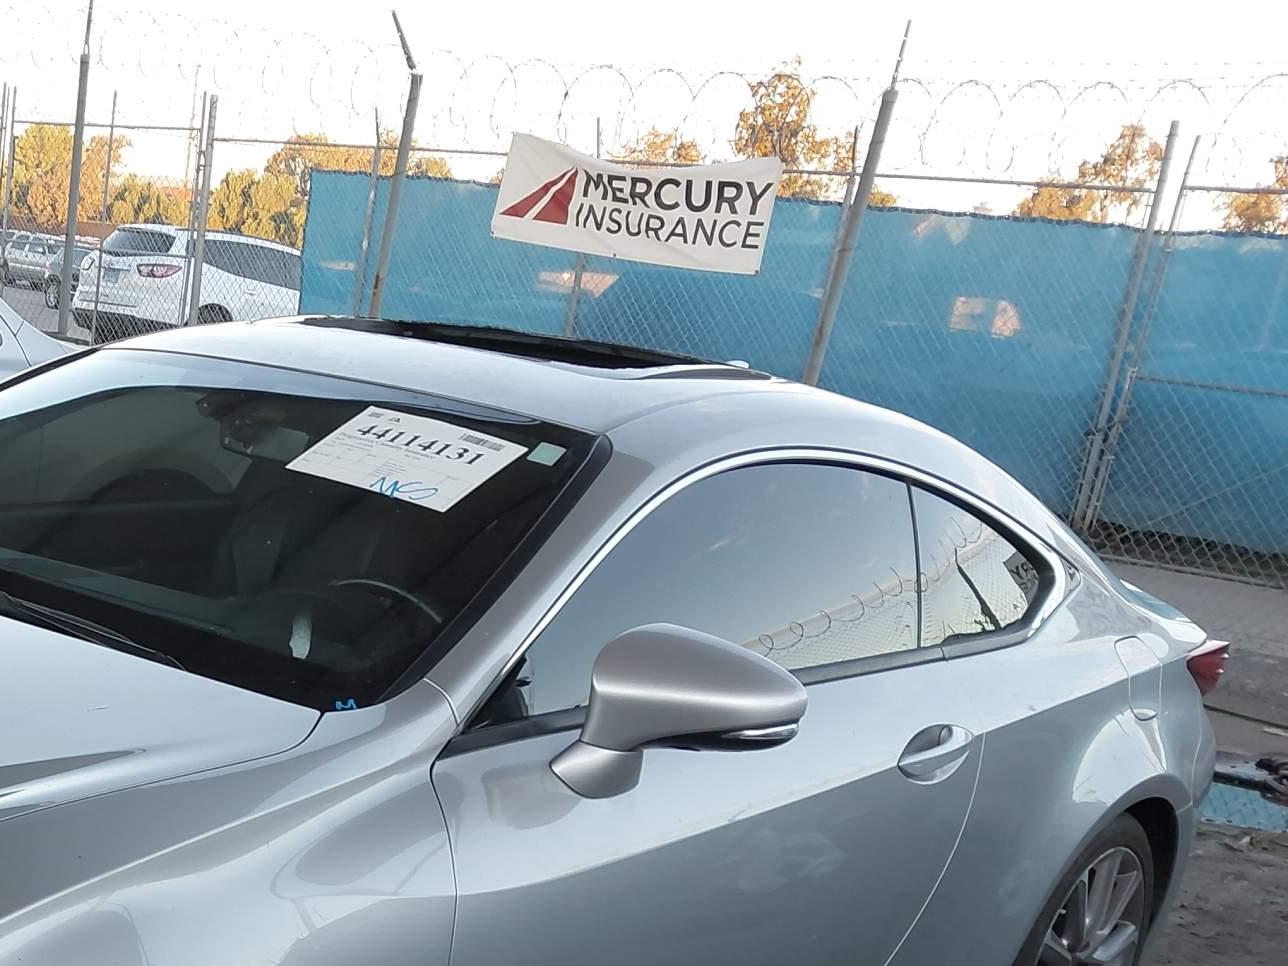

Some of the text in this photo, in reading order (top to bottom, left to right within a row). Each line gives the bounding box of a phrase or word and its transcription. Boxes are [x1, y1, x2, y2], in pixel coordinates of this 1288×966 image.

[582, 169, 774, 216] MERCURY
[575, 204, 765, 250] INSURANCE
[357, 425, 484, 465] 44114131
